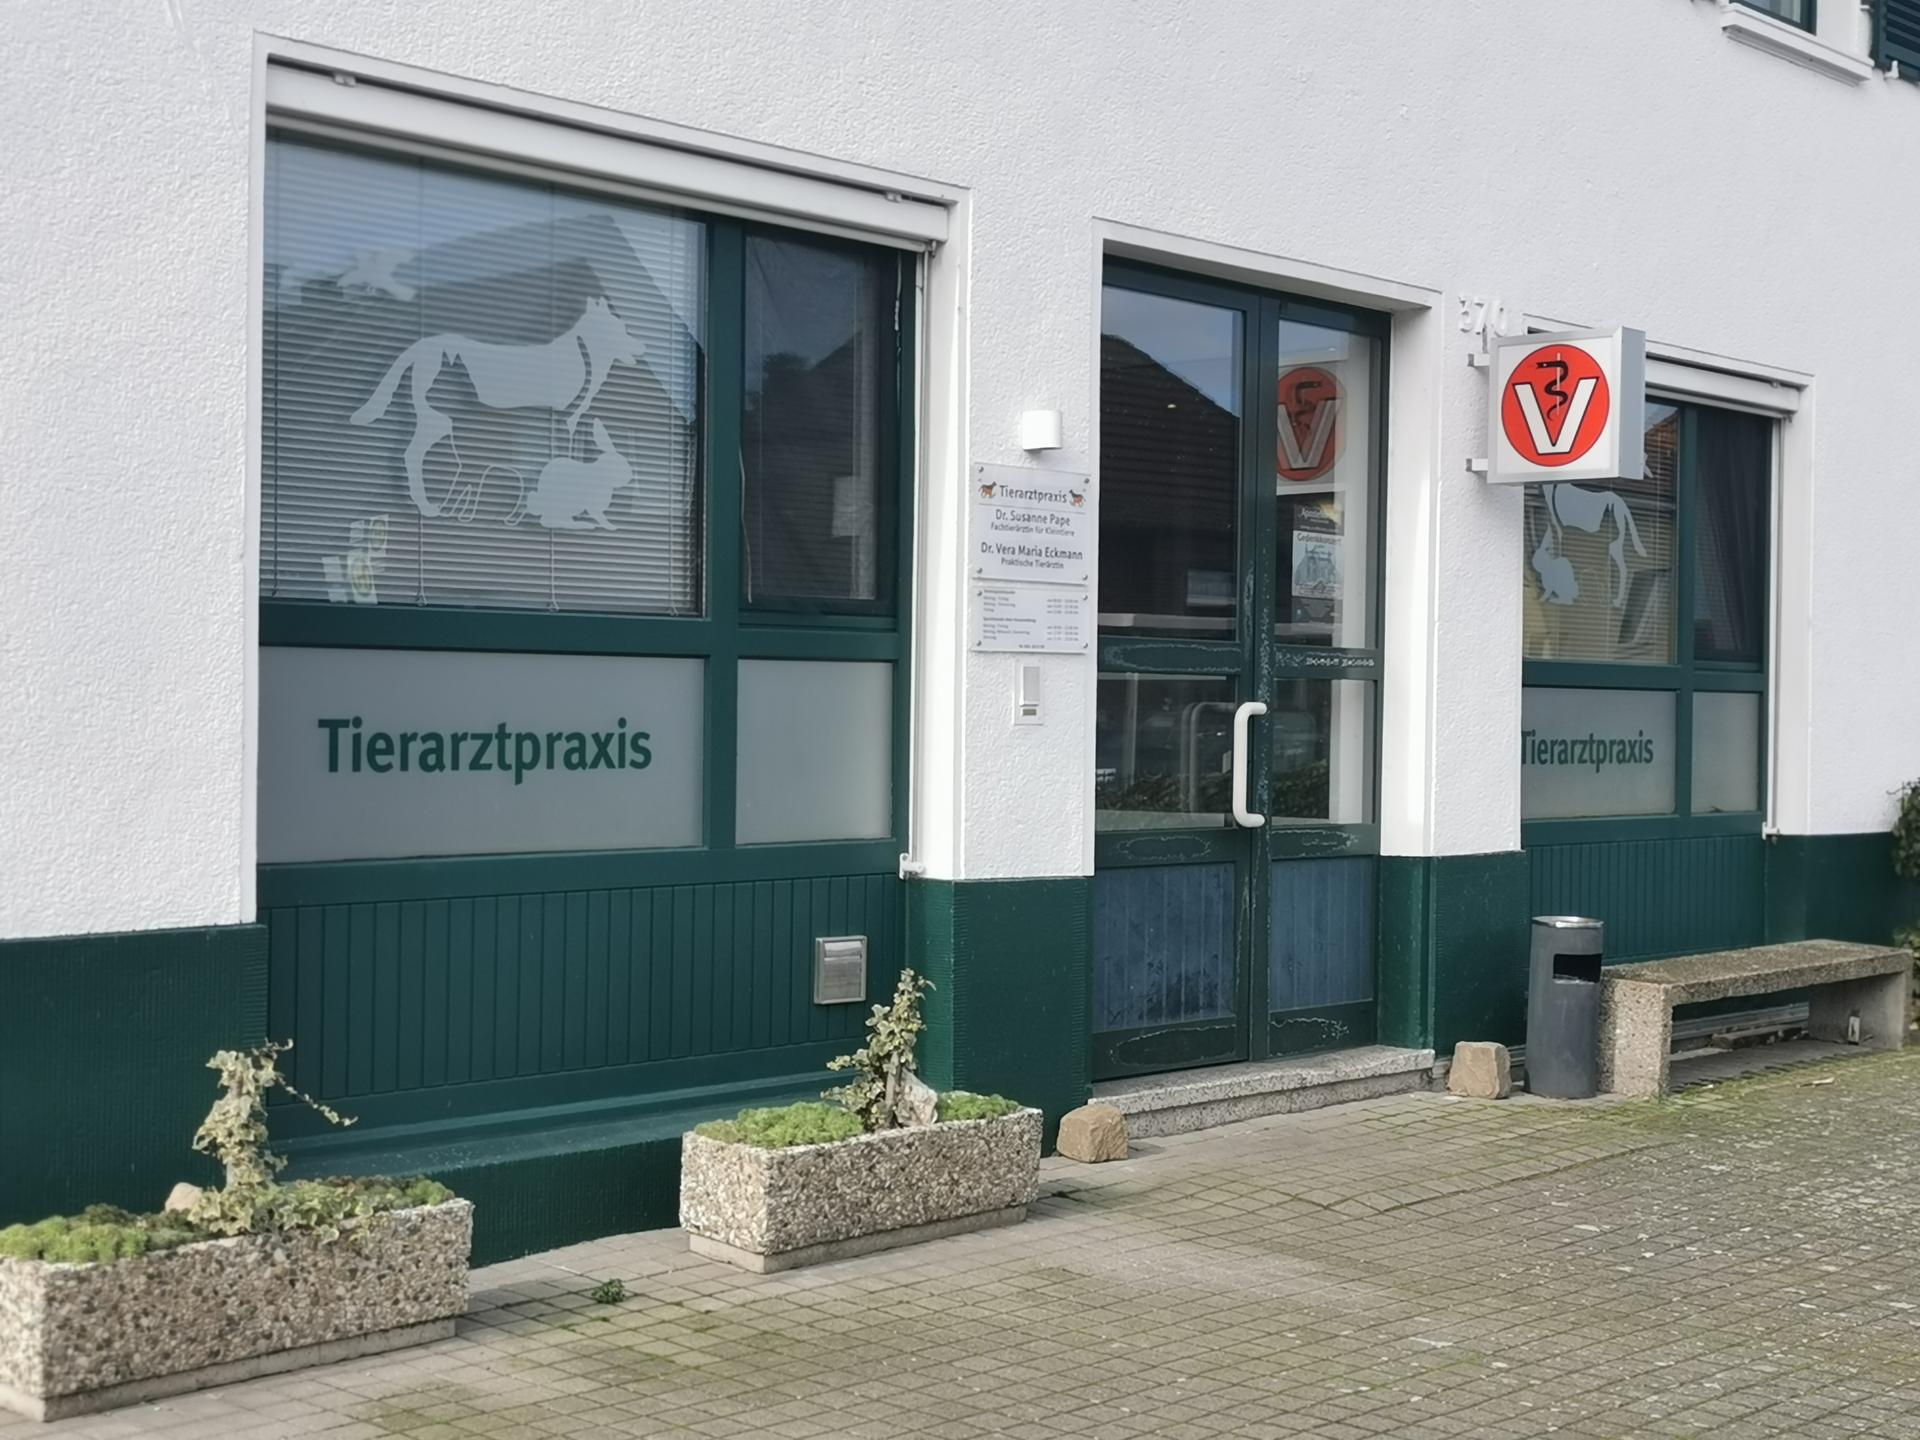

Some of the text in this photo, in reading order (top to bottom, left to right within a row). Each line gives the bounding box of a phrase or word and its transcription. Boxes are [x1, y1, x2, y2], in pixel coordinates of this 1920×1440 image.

[1458, 295, 1507, 337] 370
[1512, 377, 1600, 456] V
[1000, 485, 1067, 504] Tierarztpraxis
[995, 509, 1070, 528] Dr. Susanne Pape
[981, 541, 1083, 561] Dr. Vera Maria Eckmann
[318, 716, 652, 785] Tierarztpraxis
[1521, 729, 1654, 773] Tierarztpraxis
